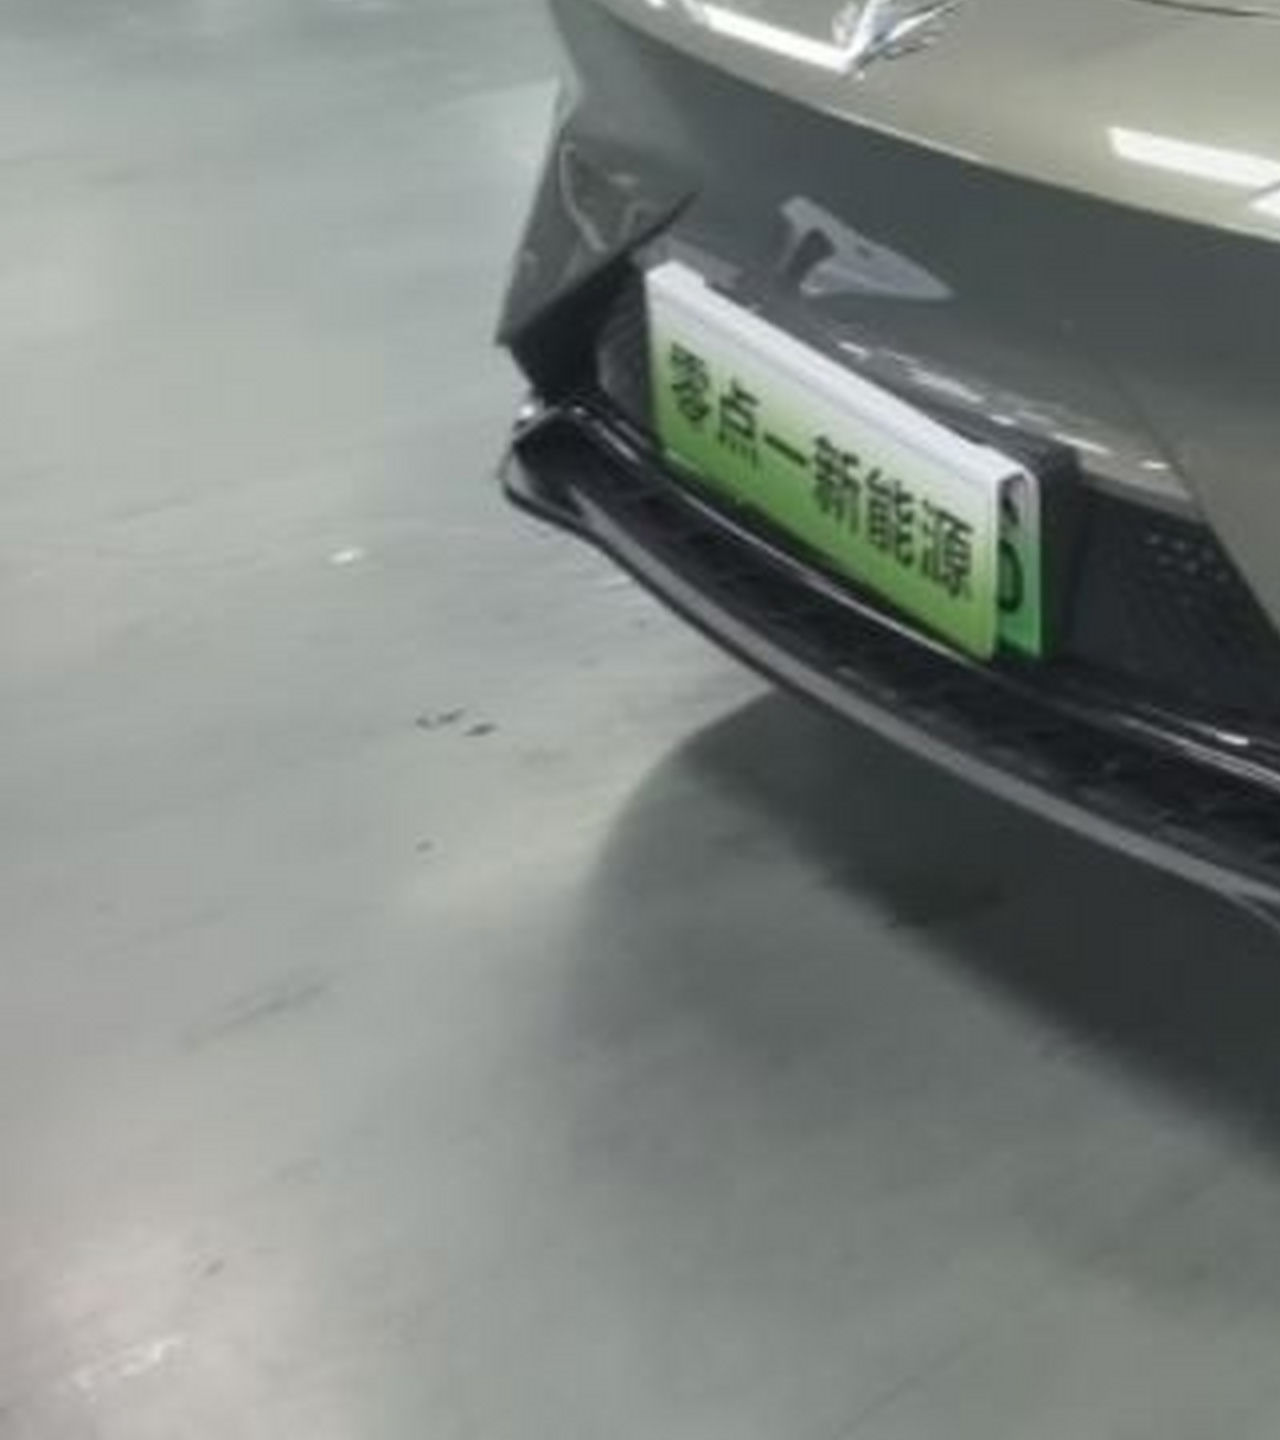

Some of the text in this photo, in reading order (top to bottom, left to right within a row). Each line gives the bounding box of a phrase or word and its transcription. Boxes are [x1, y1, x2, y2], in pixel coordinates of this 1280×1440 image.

[671, 342, 977, 600] 零点一新能源
